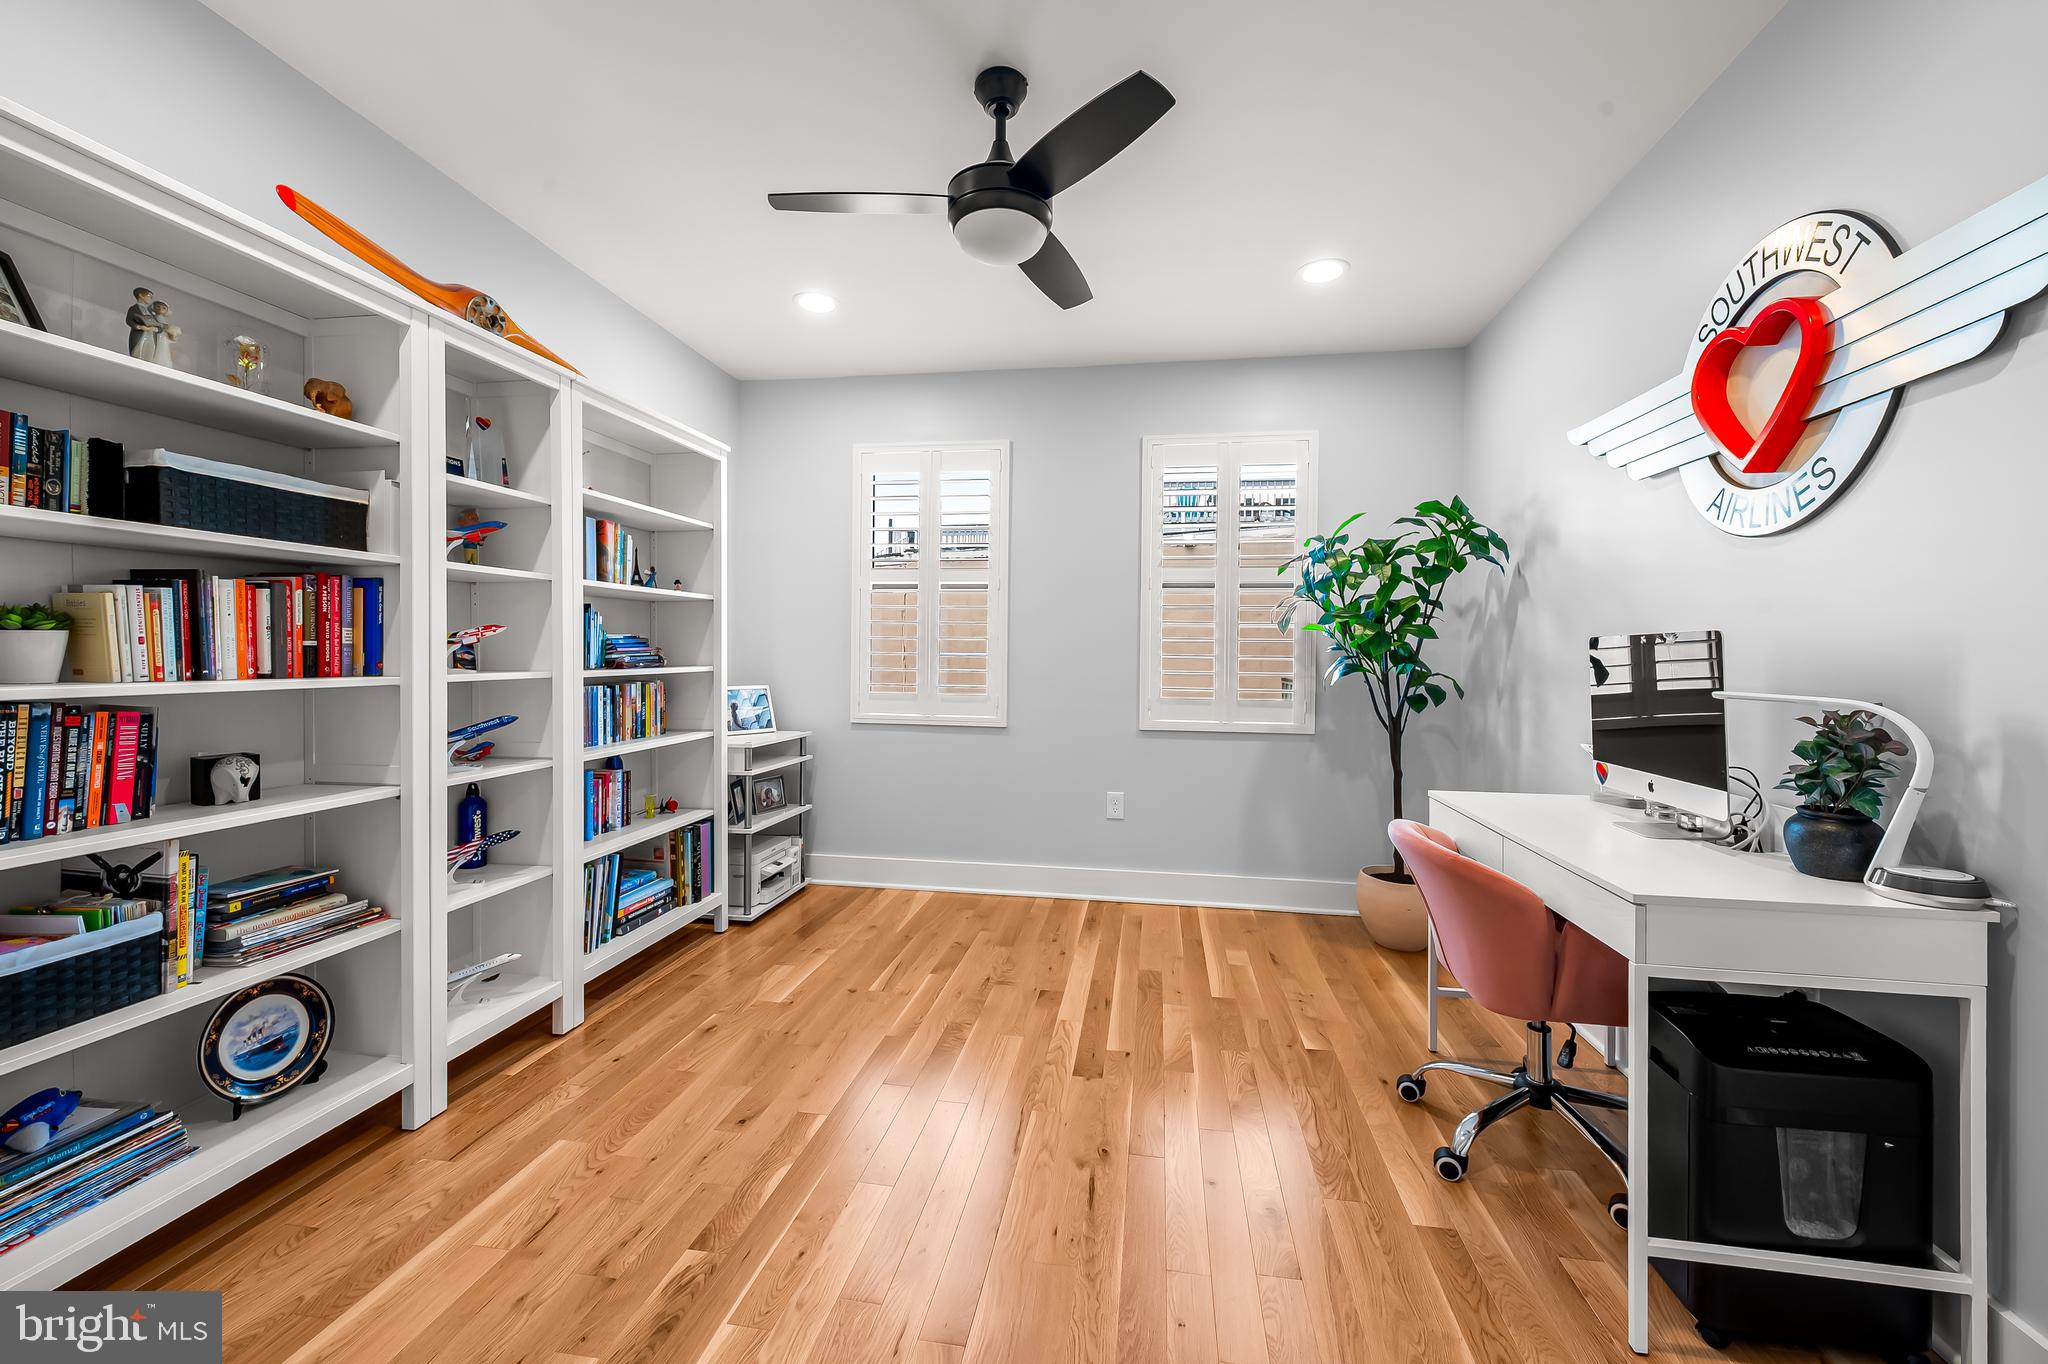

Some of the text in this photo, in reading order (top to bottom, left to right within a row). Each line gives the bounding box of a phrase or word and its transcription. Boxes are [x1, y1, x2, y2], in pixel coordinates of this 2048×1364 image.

[1697, 220, 1872, 347] SOUTHWEST
[1706, 455, 1837, 530] AIRLINES
[6, 721, 16, 770] BEYOND
[39, 724, 48, 753] NERVES
[52, 726, 61, 762] INVESTIGATING
[68, 728, 78, 746] FAILURE
[119, 726, 137, 745] HARD
[140, 722, 149, 749] SULLY
[67, 753, 75, 763] NOT
[116, 748, 135, 780] LANDING
[37, 760, 45, 784] STEEL
[50, 763, 59, 782] HUMAN
[65, 772, 75, 788] OPTION
[49, 782, 58, 799] ERROR
[179, 905, 187, 948] EMERGENCY
[236, 907, 316, 936] the new menopause
[47, 1144, 81, 1164] Manual
